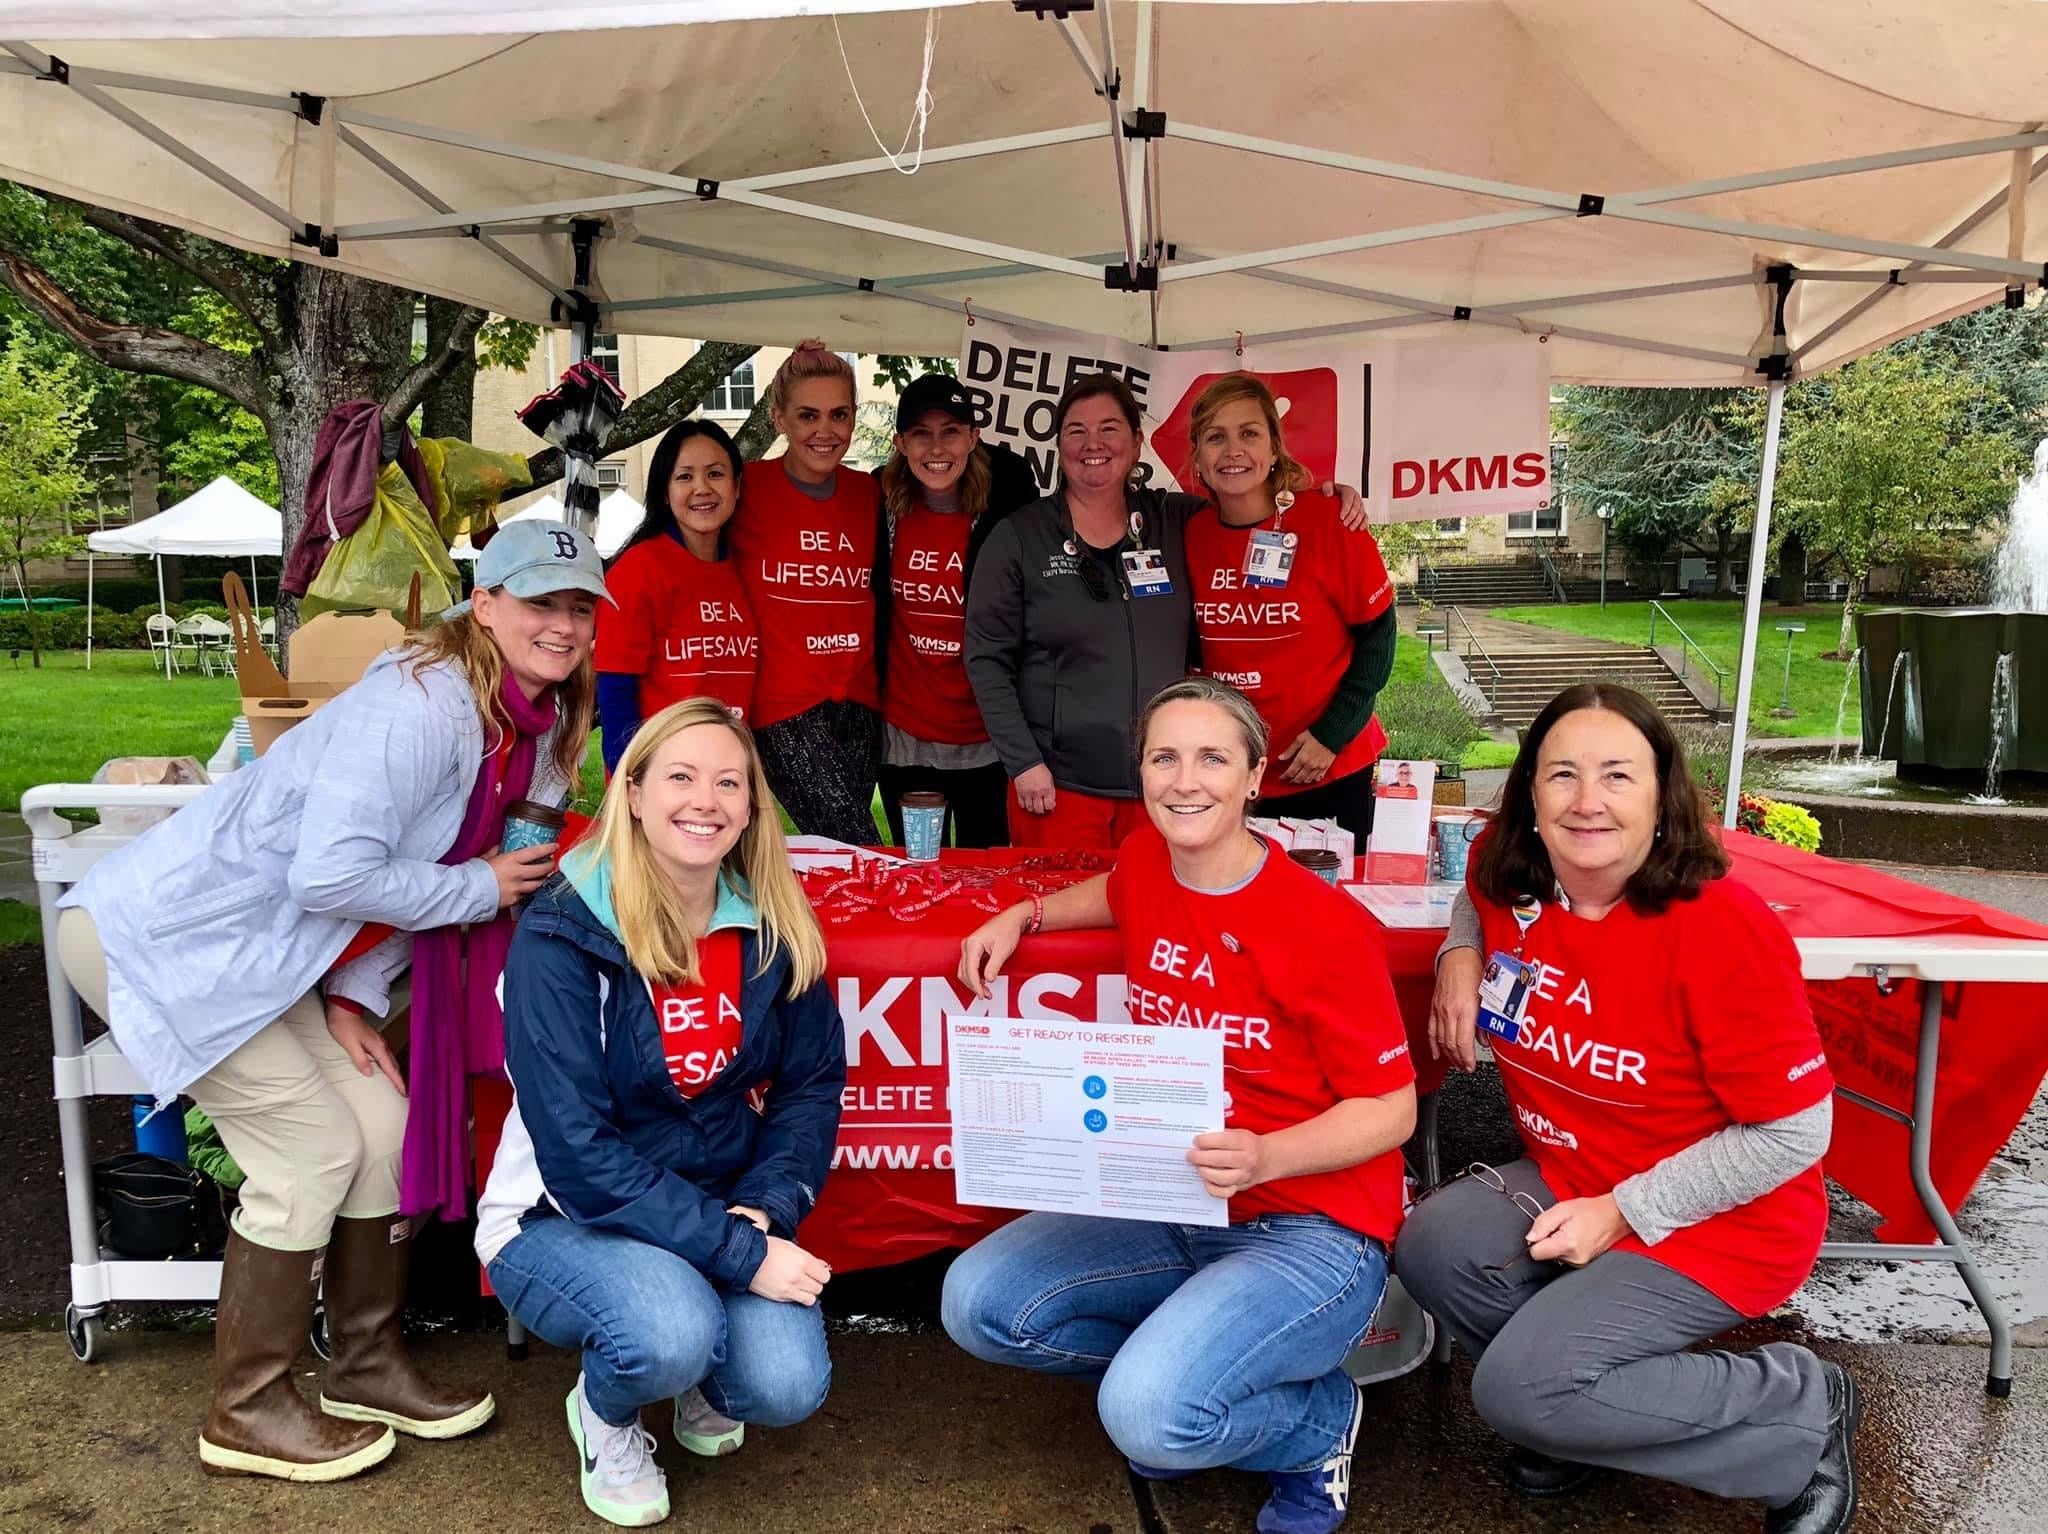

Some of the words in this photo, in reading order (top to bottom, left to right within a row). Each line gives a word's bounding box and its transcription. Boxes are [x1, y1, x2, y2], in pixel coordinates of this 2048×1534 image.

[965, 386, 1058, 442] BLO
[1391, 452, 1547, 499] DKMS
[547, 530, 578, 560] B
[800, 530, 832, 552] BE
[838, 532, 855, 553] A
[762, 559, 872, 588] LIFESAVE
[908, 550, 940, 572] BE
[945, 551, 964, 573] A
[1146, 585, 1161, 593] RN
[1210, 568, 1238, 590] BE
[889, 578, 965, 606] FESAV
[699, 601, 727, 623] BE
[729, 602, 744, 623] A
[1194, 602, 1302, 625] FESAVER
[665, 635, 759, 660] LIFESAVE
[806, 634, 848, 650] DKMS
[909, 633, 948, 651] DKMS
[1149, 937, 1189, 979] BE
[1191, 952, 1216, 988] A
[1565, 977, 1593, 1015] A
[662, 996, 710, 1033] BE
[718, 992, 742, 1025] A
[836, 973, 1082, 1067] KM
[1128, 980, 1273, 1050] FESAVER
[1488, 1016, 1507, 1034] RN
[954, 1024, 981, 1034] DKMS
[1008, 1027, 1032, 1039] GET
[1034, 1029, 1074, 1041] READY
[1076, 1031, 1094, 1042] TO
[1095, 1032, 1156, 1046] REGISTER!
[1518, 1015, 1647, 1086] SAVER
[840, 1086, 934, 1111] ELETE
